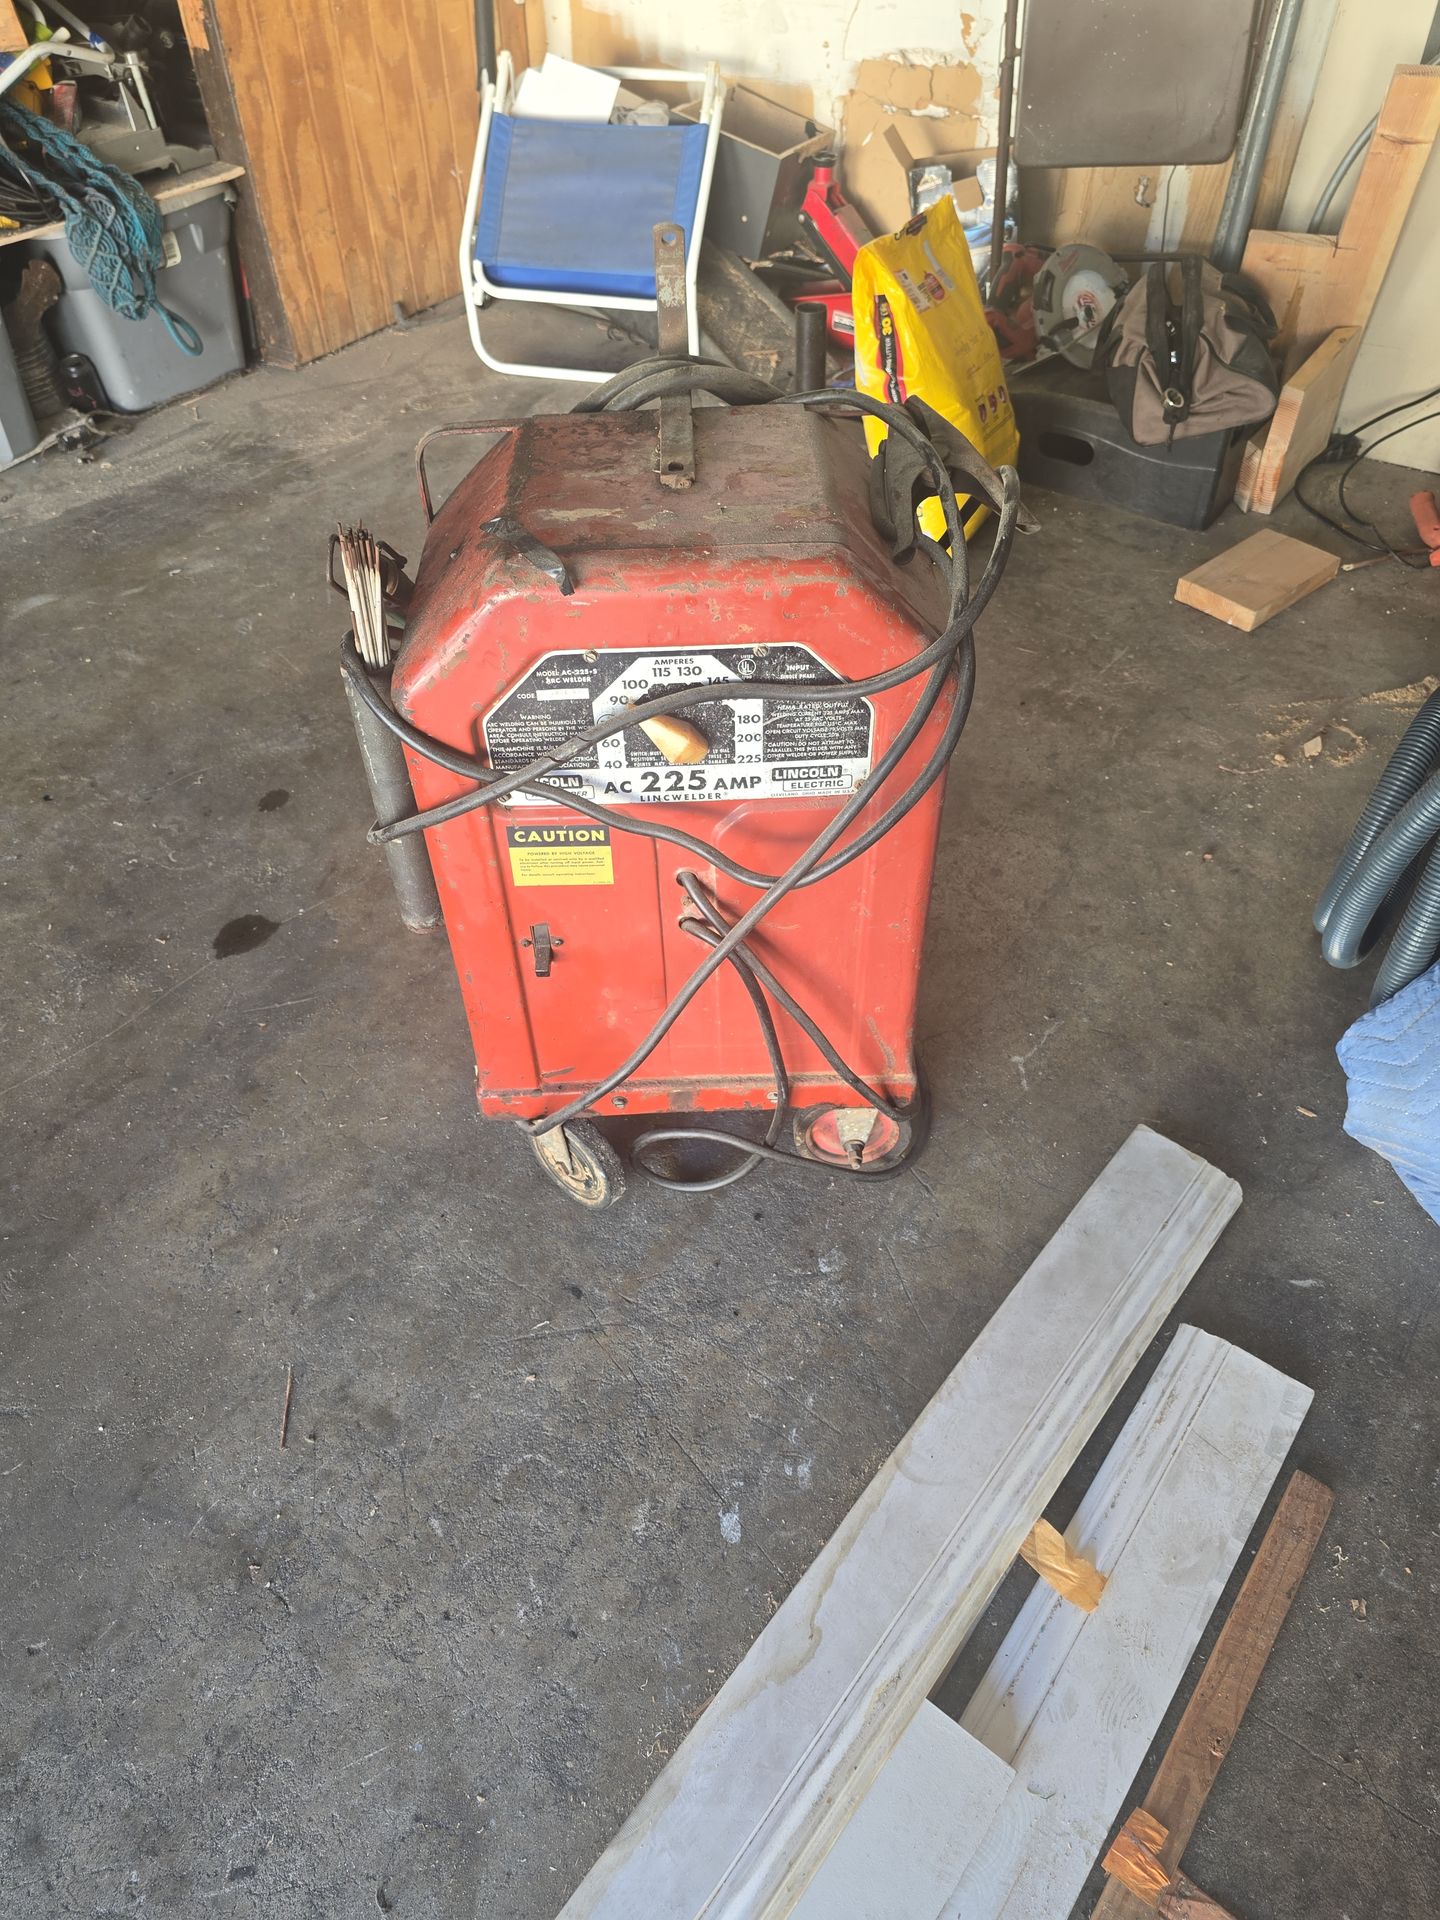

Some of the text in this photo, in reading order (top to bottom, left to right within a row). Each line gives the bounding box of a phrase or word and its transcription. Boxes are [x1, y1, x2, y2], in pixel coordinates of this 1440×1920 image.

[881, 317, 893, 336] 30
[653, 657, 694, 666] AMPERES
[651, 665, 702, 677] 115 130
[786, 663, 809, 671] INPUT
[621, 679, 649, 690] 100
[609, 695, 629, 706] 90
[737, 714, 761, 724] 180
[602, 738, 620, 748] 60
[737, 733, 762, 743] 200
[737, 754, 762, 764] 225
[604, 761, 622, 769] 40
[774, 766, 839, 780] LINCOLN
[604, 780, 633, 794] AC
[640, 769, 707, 793] 225
[713, 775, 762, 791] AMP
[790, 779, 844, 789] ELECTRIC
[513, 829, 605, 843] CAUTION
